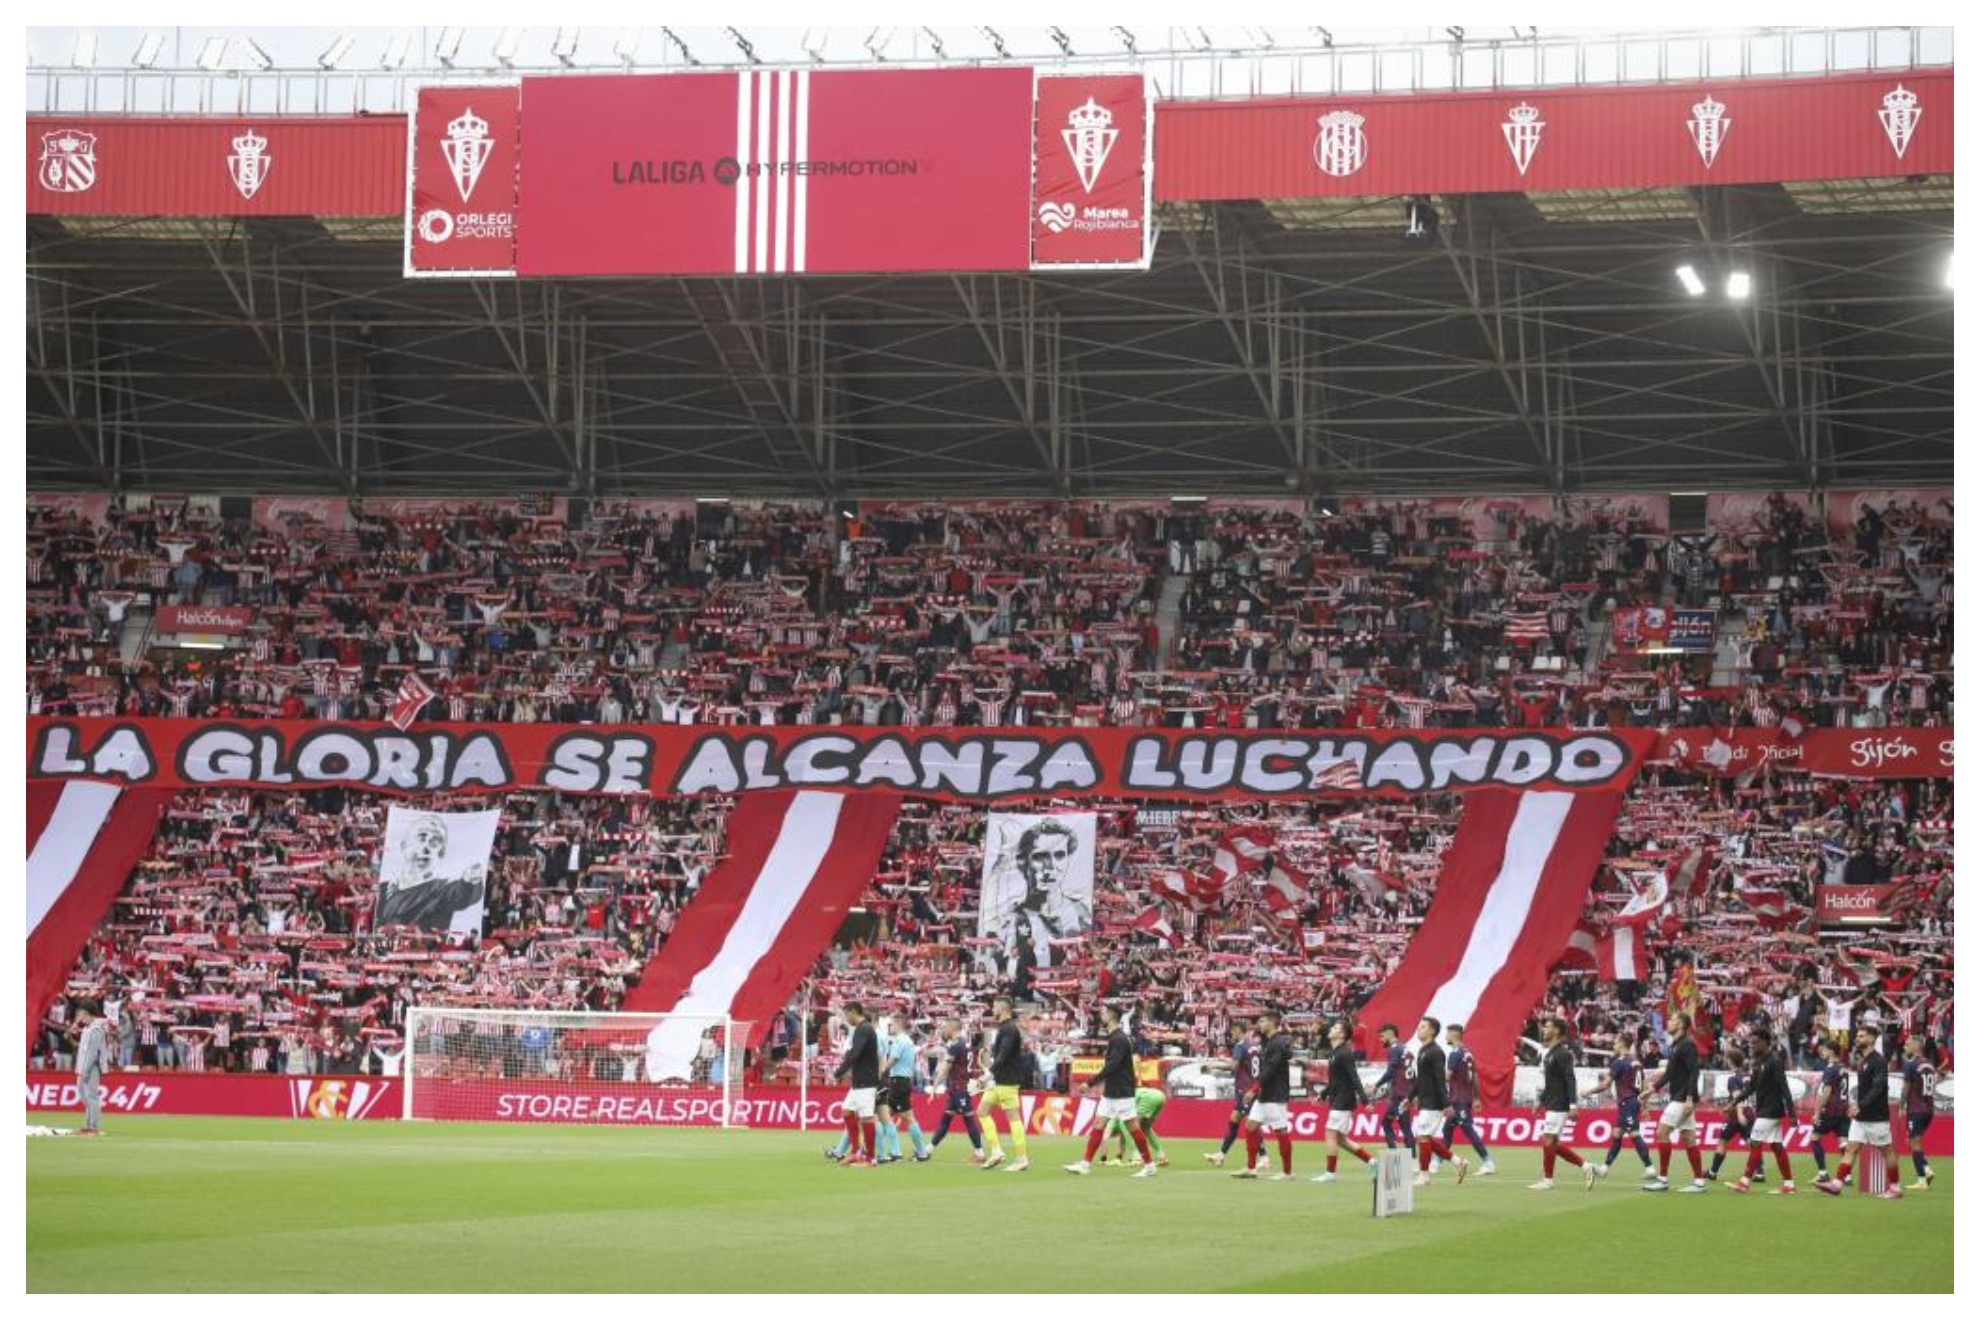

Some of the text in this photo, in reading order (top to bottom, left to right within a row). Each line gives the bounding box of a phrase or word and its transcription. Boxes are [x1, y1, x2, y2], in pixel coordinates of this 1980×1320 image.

[612, 160, 706, 184] LALIGA
[746, 159, 918, 177] HYPERMOTION
[456, 213, 513, 225] ORLEGI
[1083, 207, 1129, 219] Marea
[456, 226, 513, 238] SPORTS
[38, 725, 1627, 795] LA GLORIA SE ALCANZA LUCHANDO
[1850, 736, 1918, 768] gijón
[1250, 1056, 1260, 1078] 8
[1921, 1073, 1934, 1097] 19
